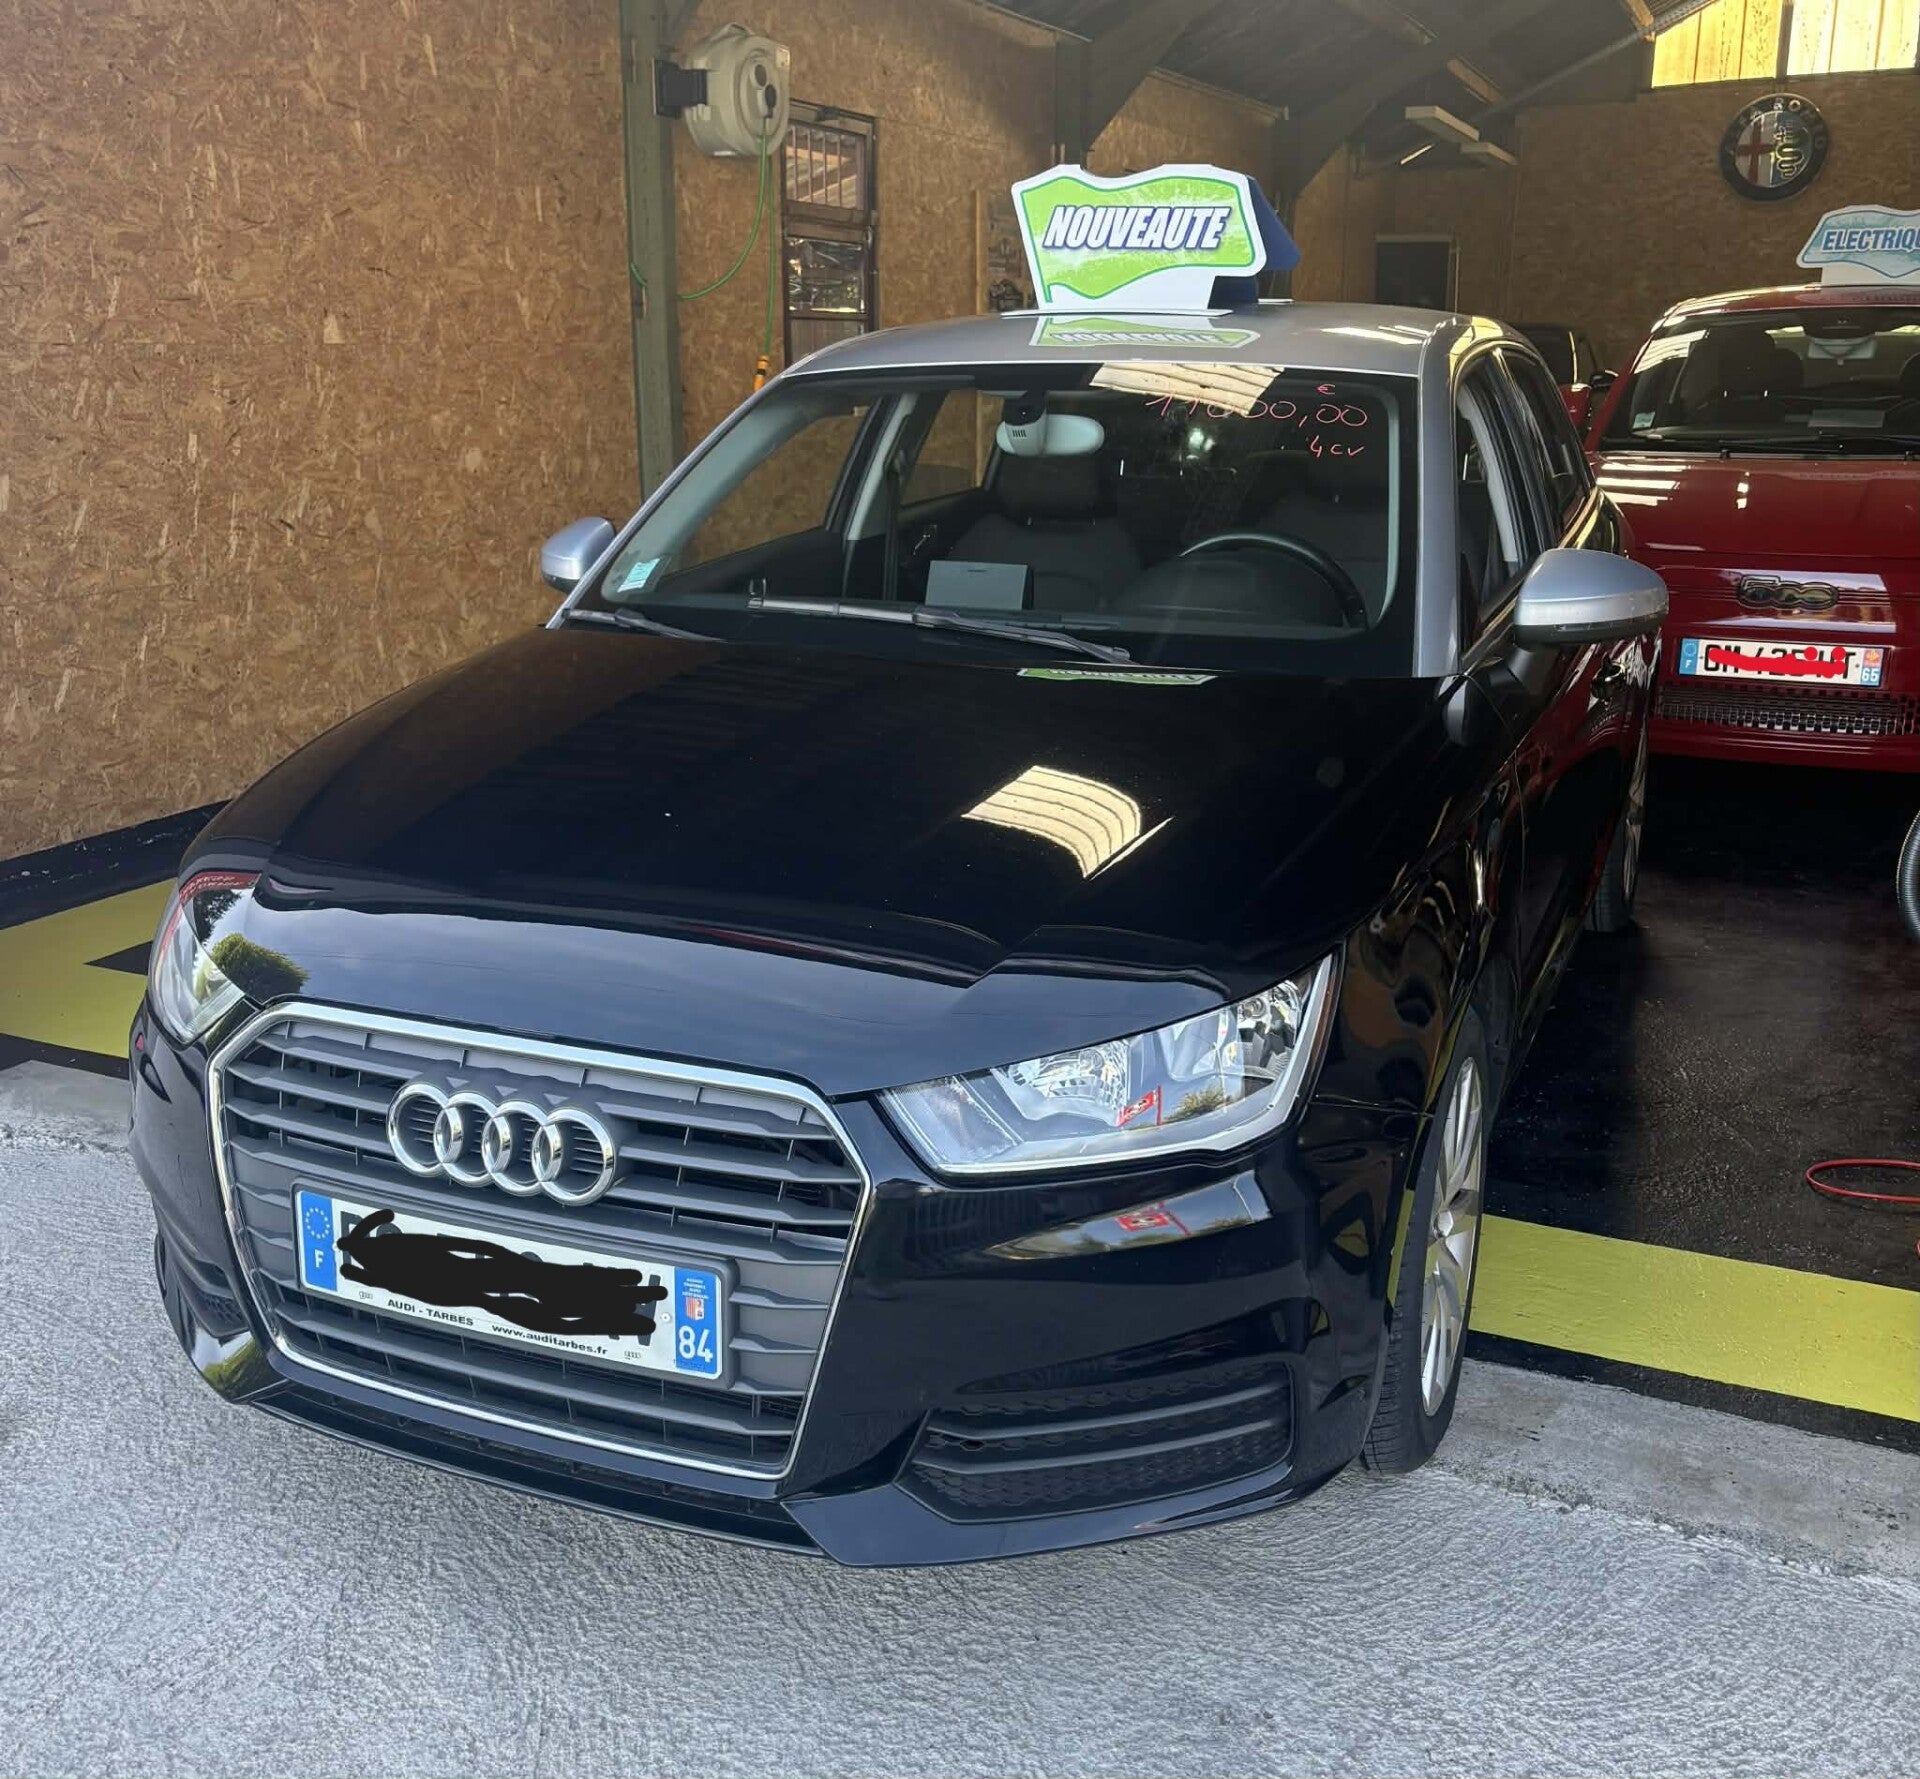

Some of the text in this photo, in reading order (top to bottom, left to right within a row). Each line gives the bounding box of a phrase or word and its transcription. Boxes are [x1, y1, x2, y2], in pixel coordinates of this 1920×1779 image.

[1043, 205, 1232, 250] NOUVEAUTE
[1821, 227, 1920, 253] ELECTRIQ
[1317, 383, 1336, 395] €
[1684, 659, 1692, 669] F
[1861, 668, 1880, 682] 65
[314, 1248, 324, 1269] F
[387, 1299, 416, 1313] AUDI
[425, 1308, 474, 1327] TARBES
[491, 1324, 609, 1355] www.auditarbes.fr
[678, 1325, 714, 1363] 84
